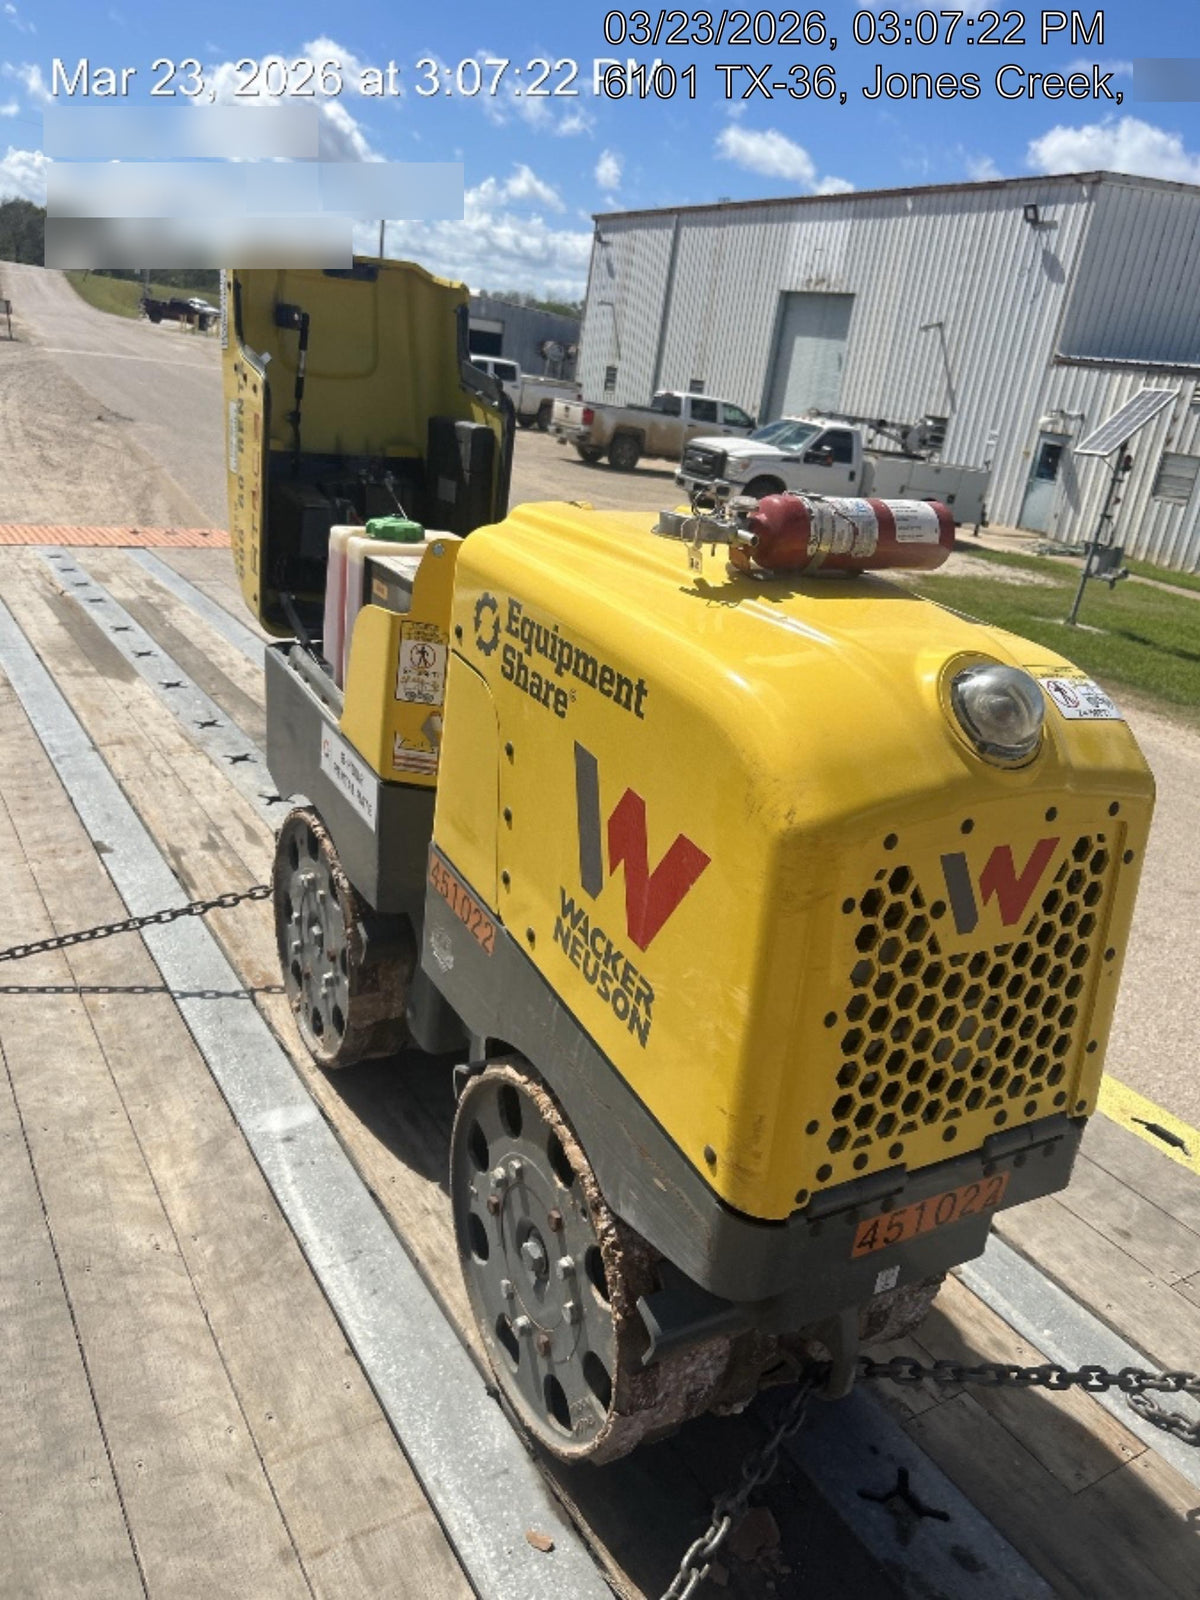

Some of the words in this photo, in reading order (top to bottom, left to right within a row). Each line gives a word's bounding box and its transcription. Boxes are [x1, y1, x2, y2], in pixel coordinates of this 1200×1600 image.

[506, 597, 648, 720] Equipment
[431, 861, 493, 954] 451022
[560, 885, 655, 1021] WACKER
[553, 915, 651, 1050] NEUSON
[856, 1176, 1004, 1250] 451022
